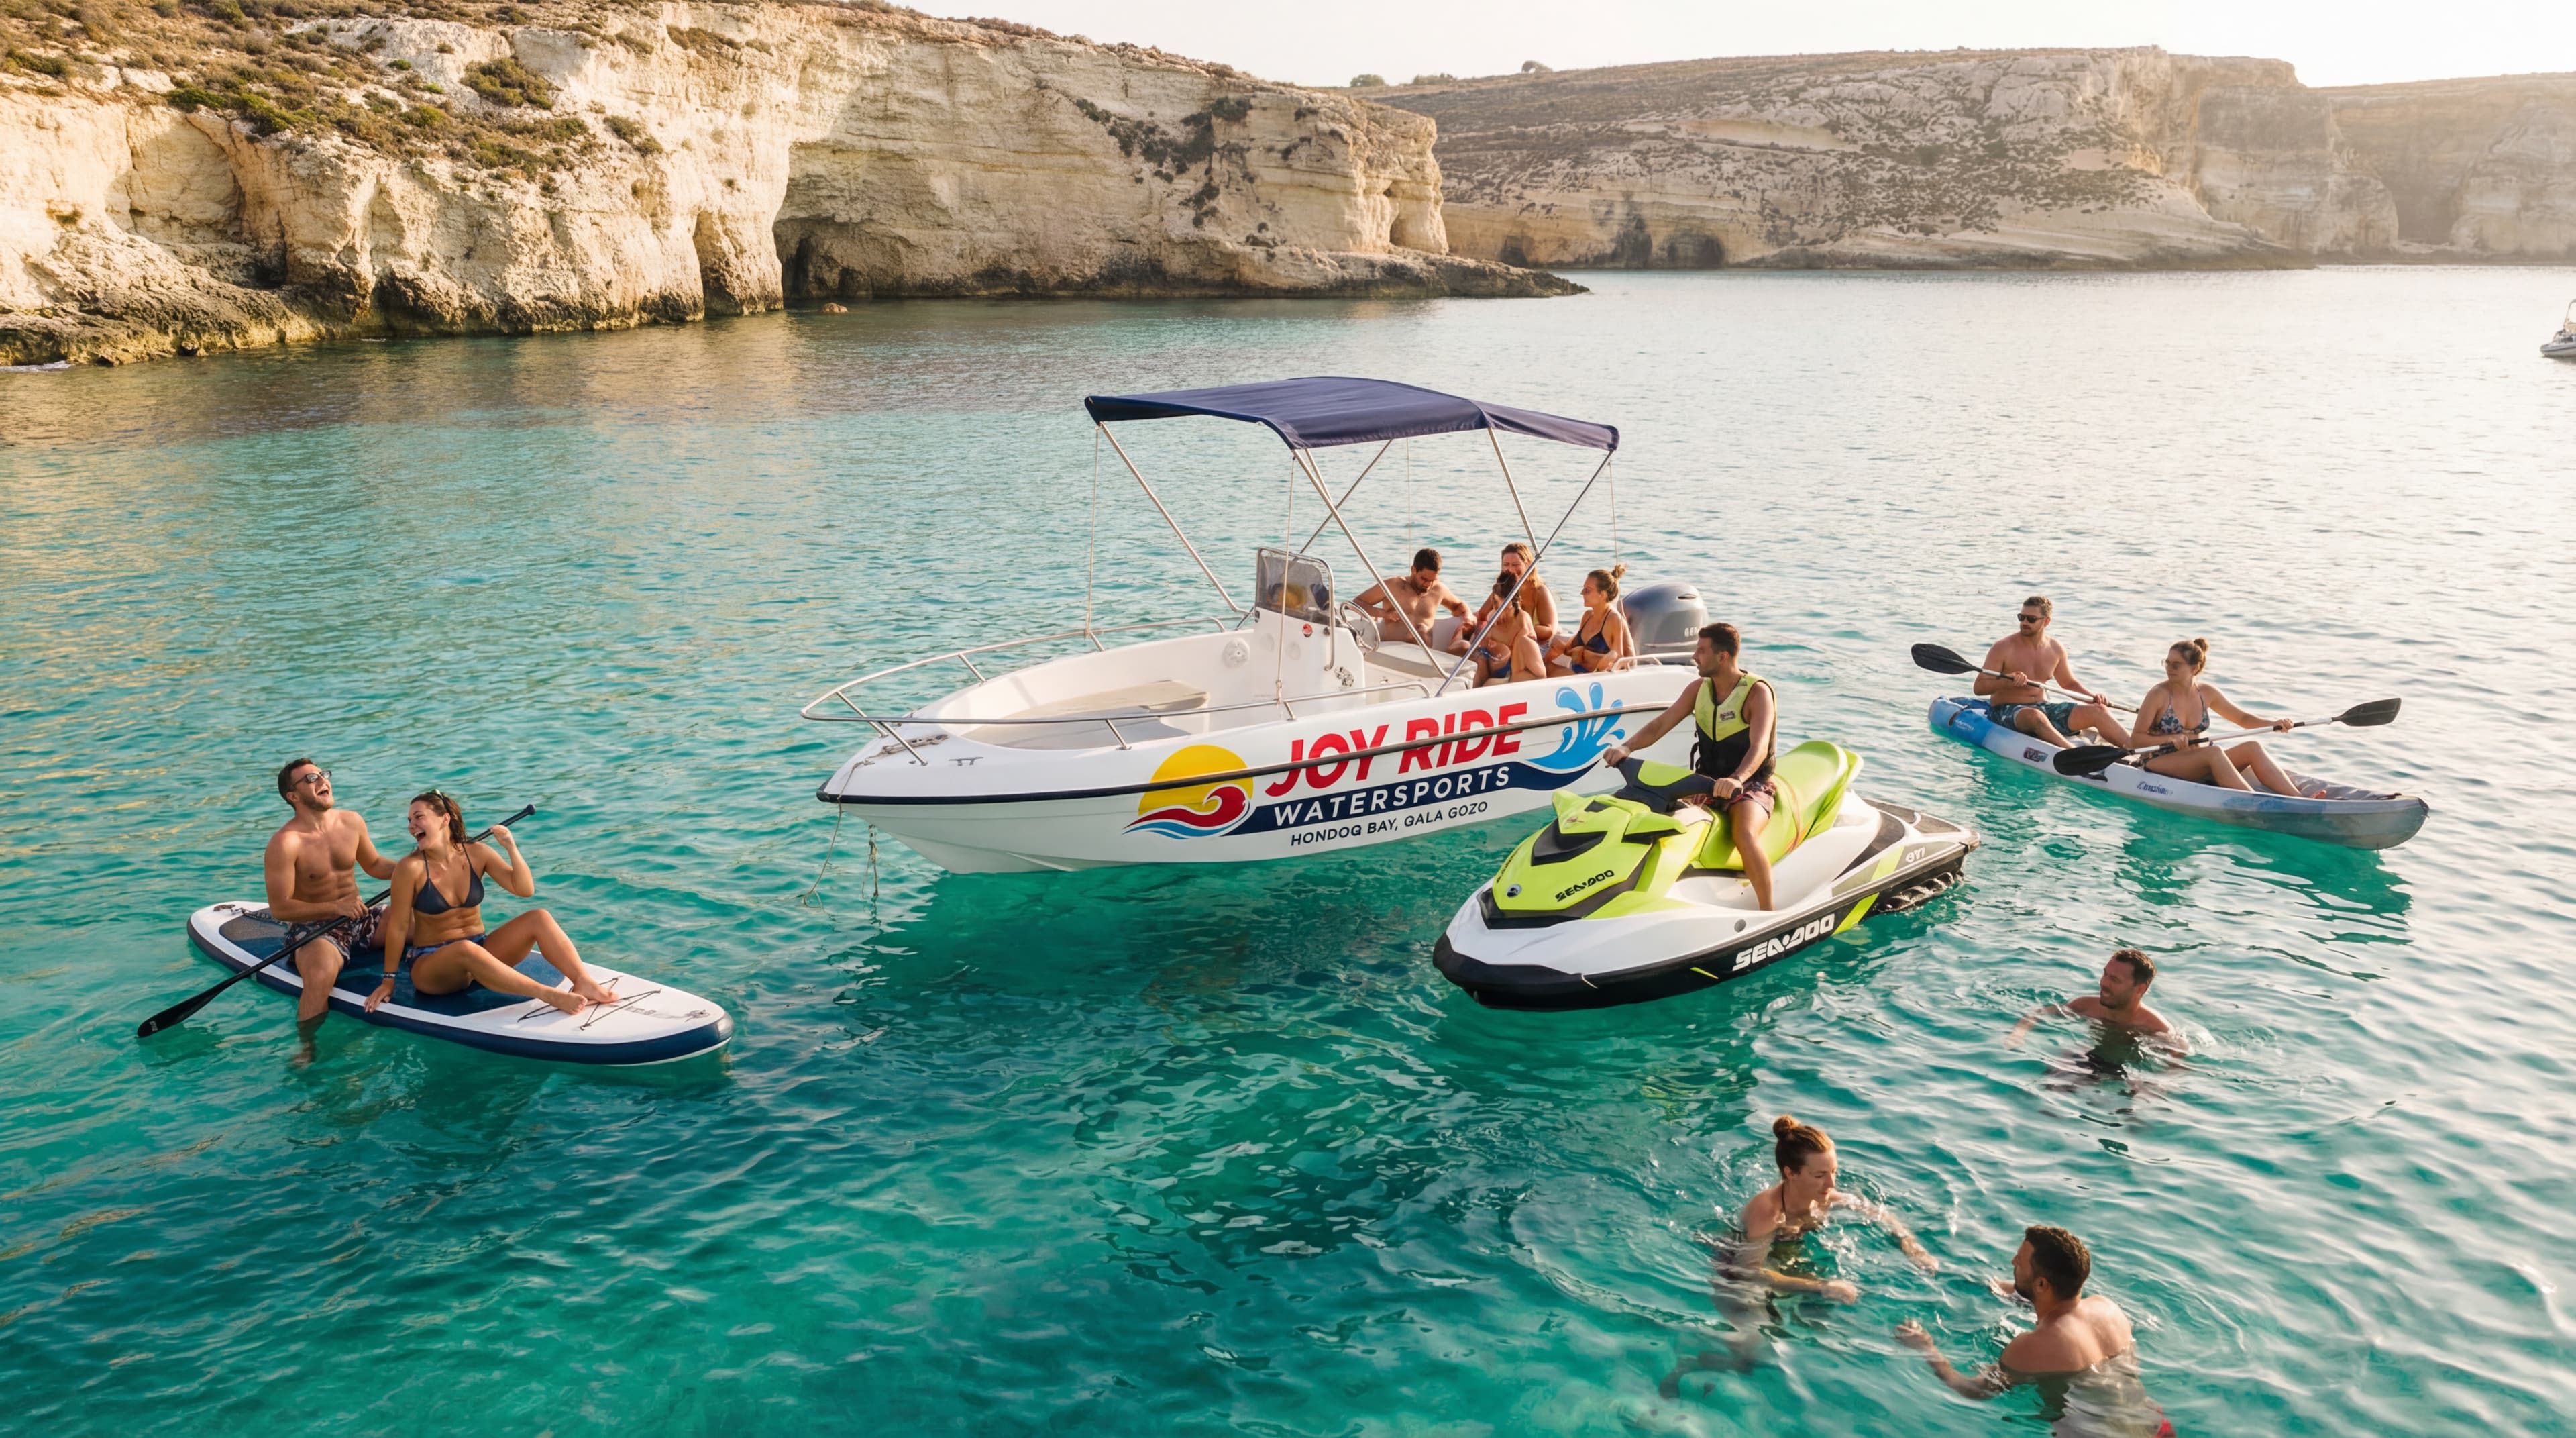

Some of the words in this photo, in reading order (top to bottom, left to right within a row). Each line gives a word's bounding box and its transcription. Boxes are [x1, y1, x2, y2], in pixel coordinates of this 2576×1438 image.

[1265, 724, 1389, 797] JOY
[1398, 702, 1527, 774] RIDE
[1274, 766, 1509, 826] WATERSPORTS
[1367, 818, 1399, 834] BAY,
[1448, 801, 1488, 819] GOZO
